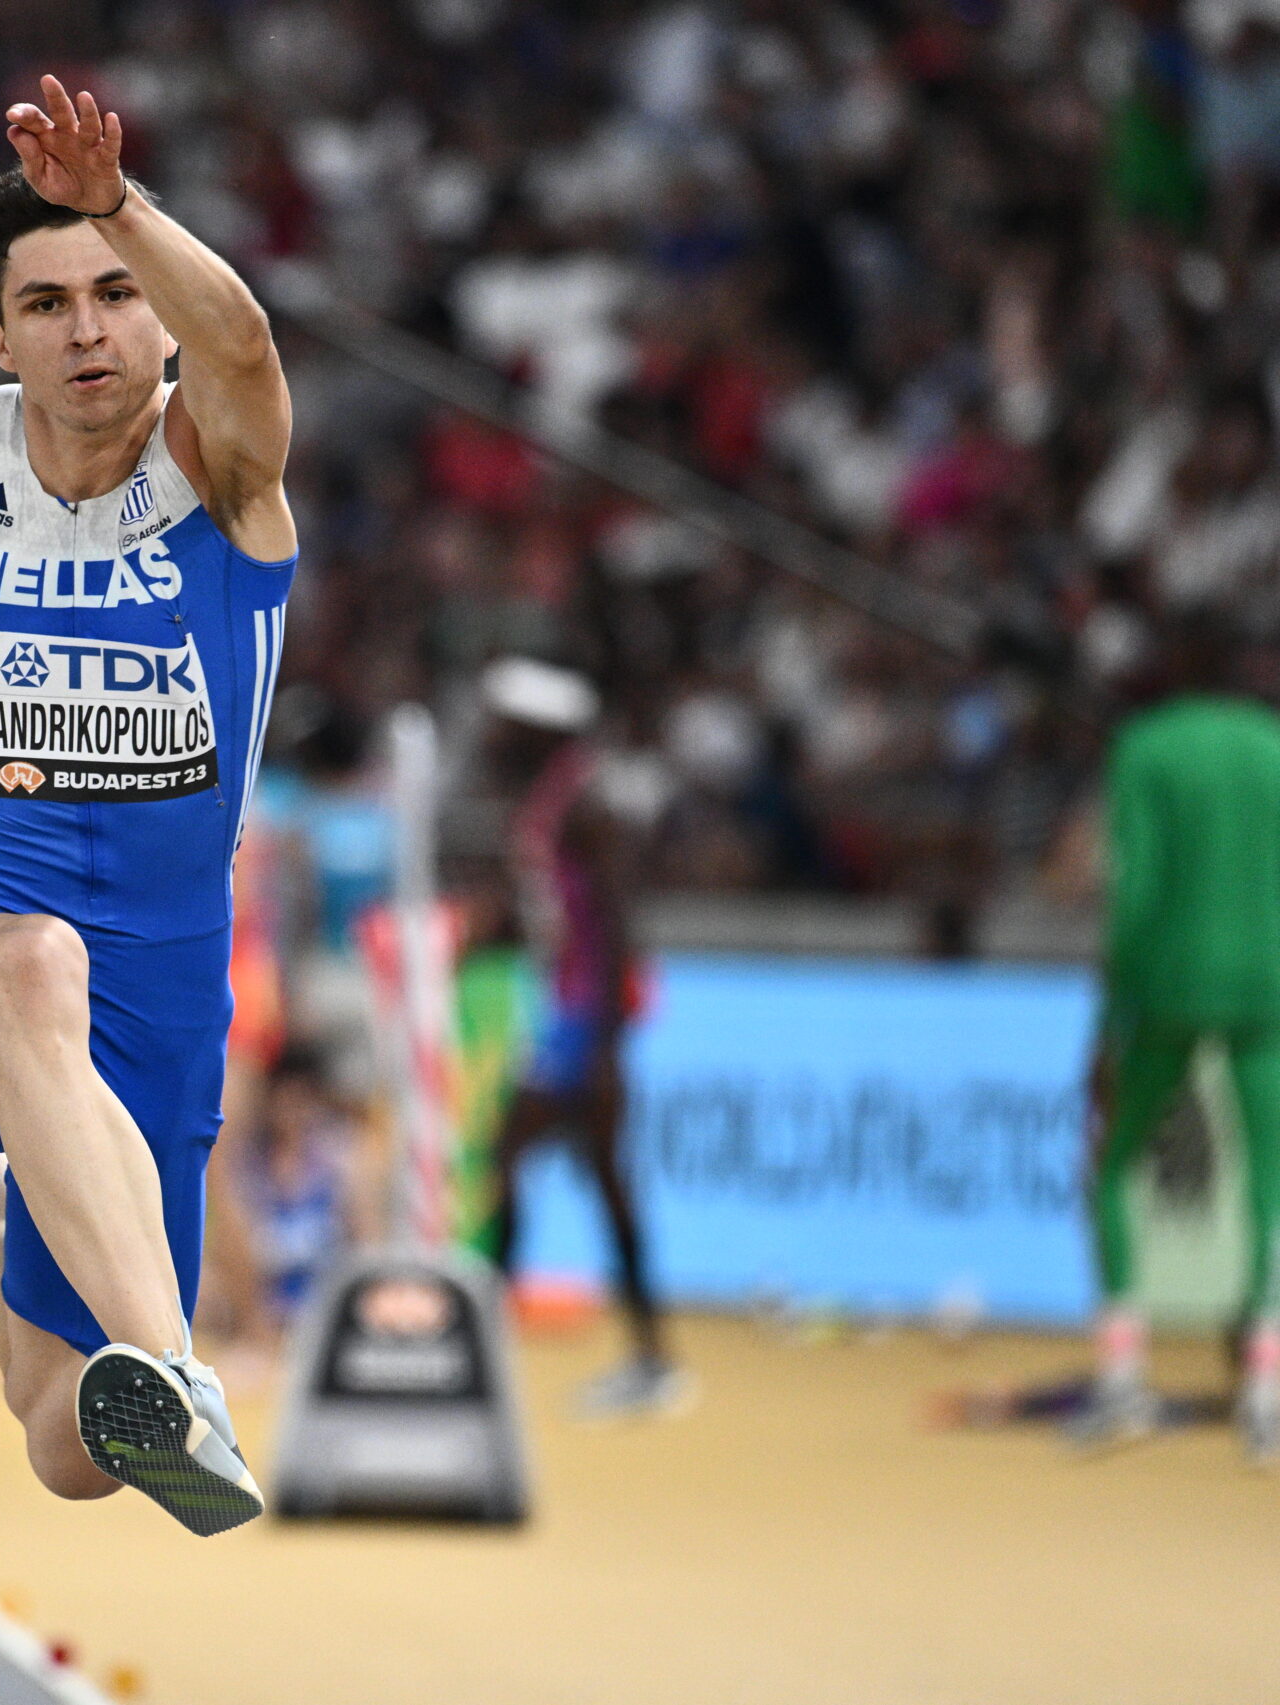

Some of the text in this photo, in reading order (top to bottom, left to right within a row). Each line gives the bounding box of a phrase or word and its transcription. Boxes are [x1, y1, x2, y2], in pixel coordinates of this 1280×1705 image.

[49, 644, 197, 695] TDK
[53, 764, 208, 790] BUDAPEST 23
